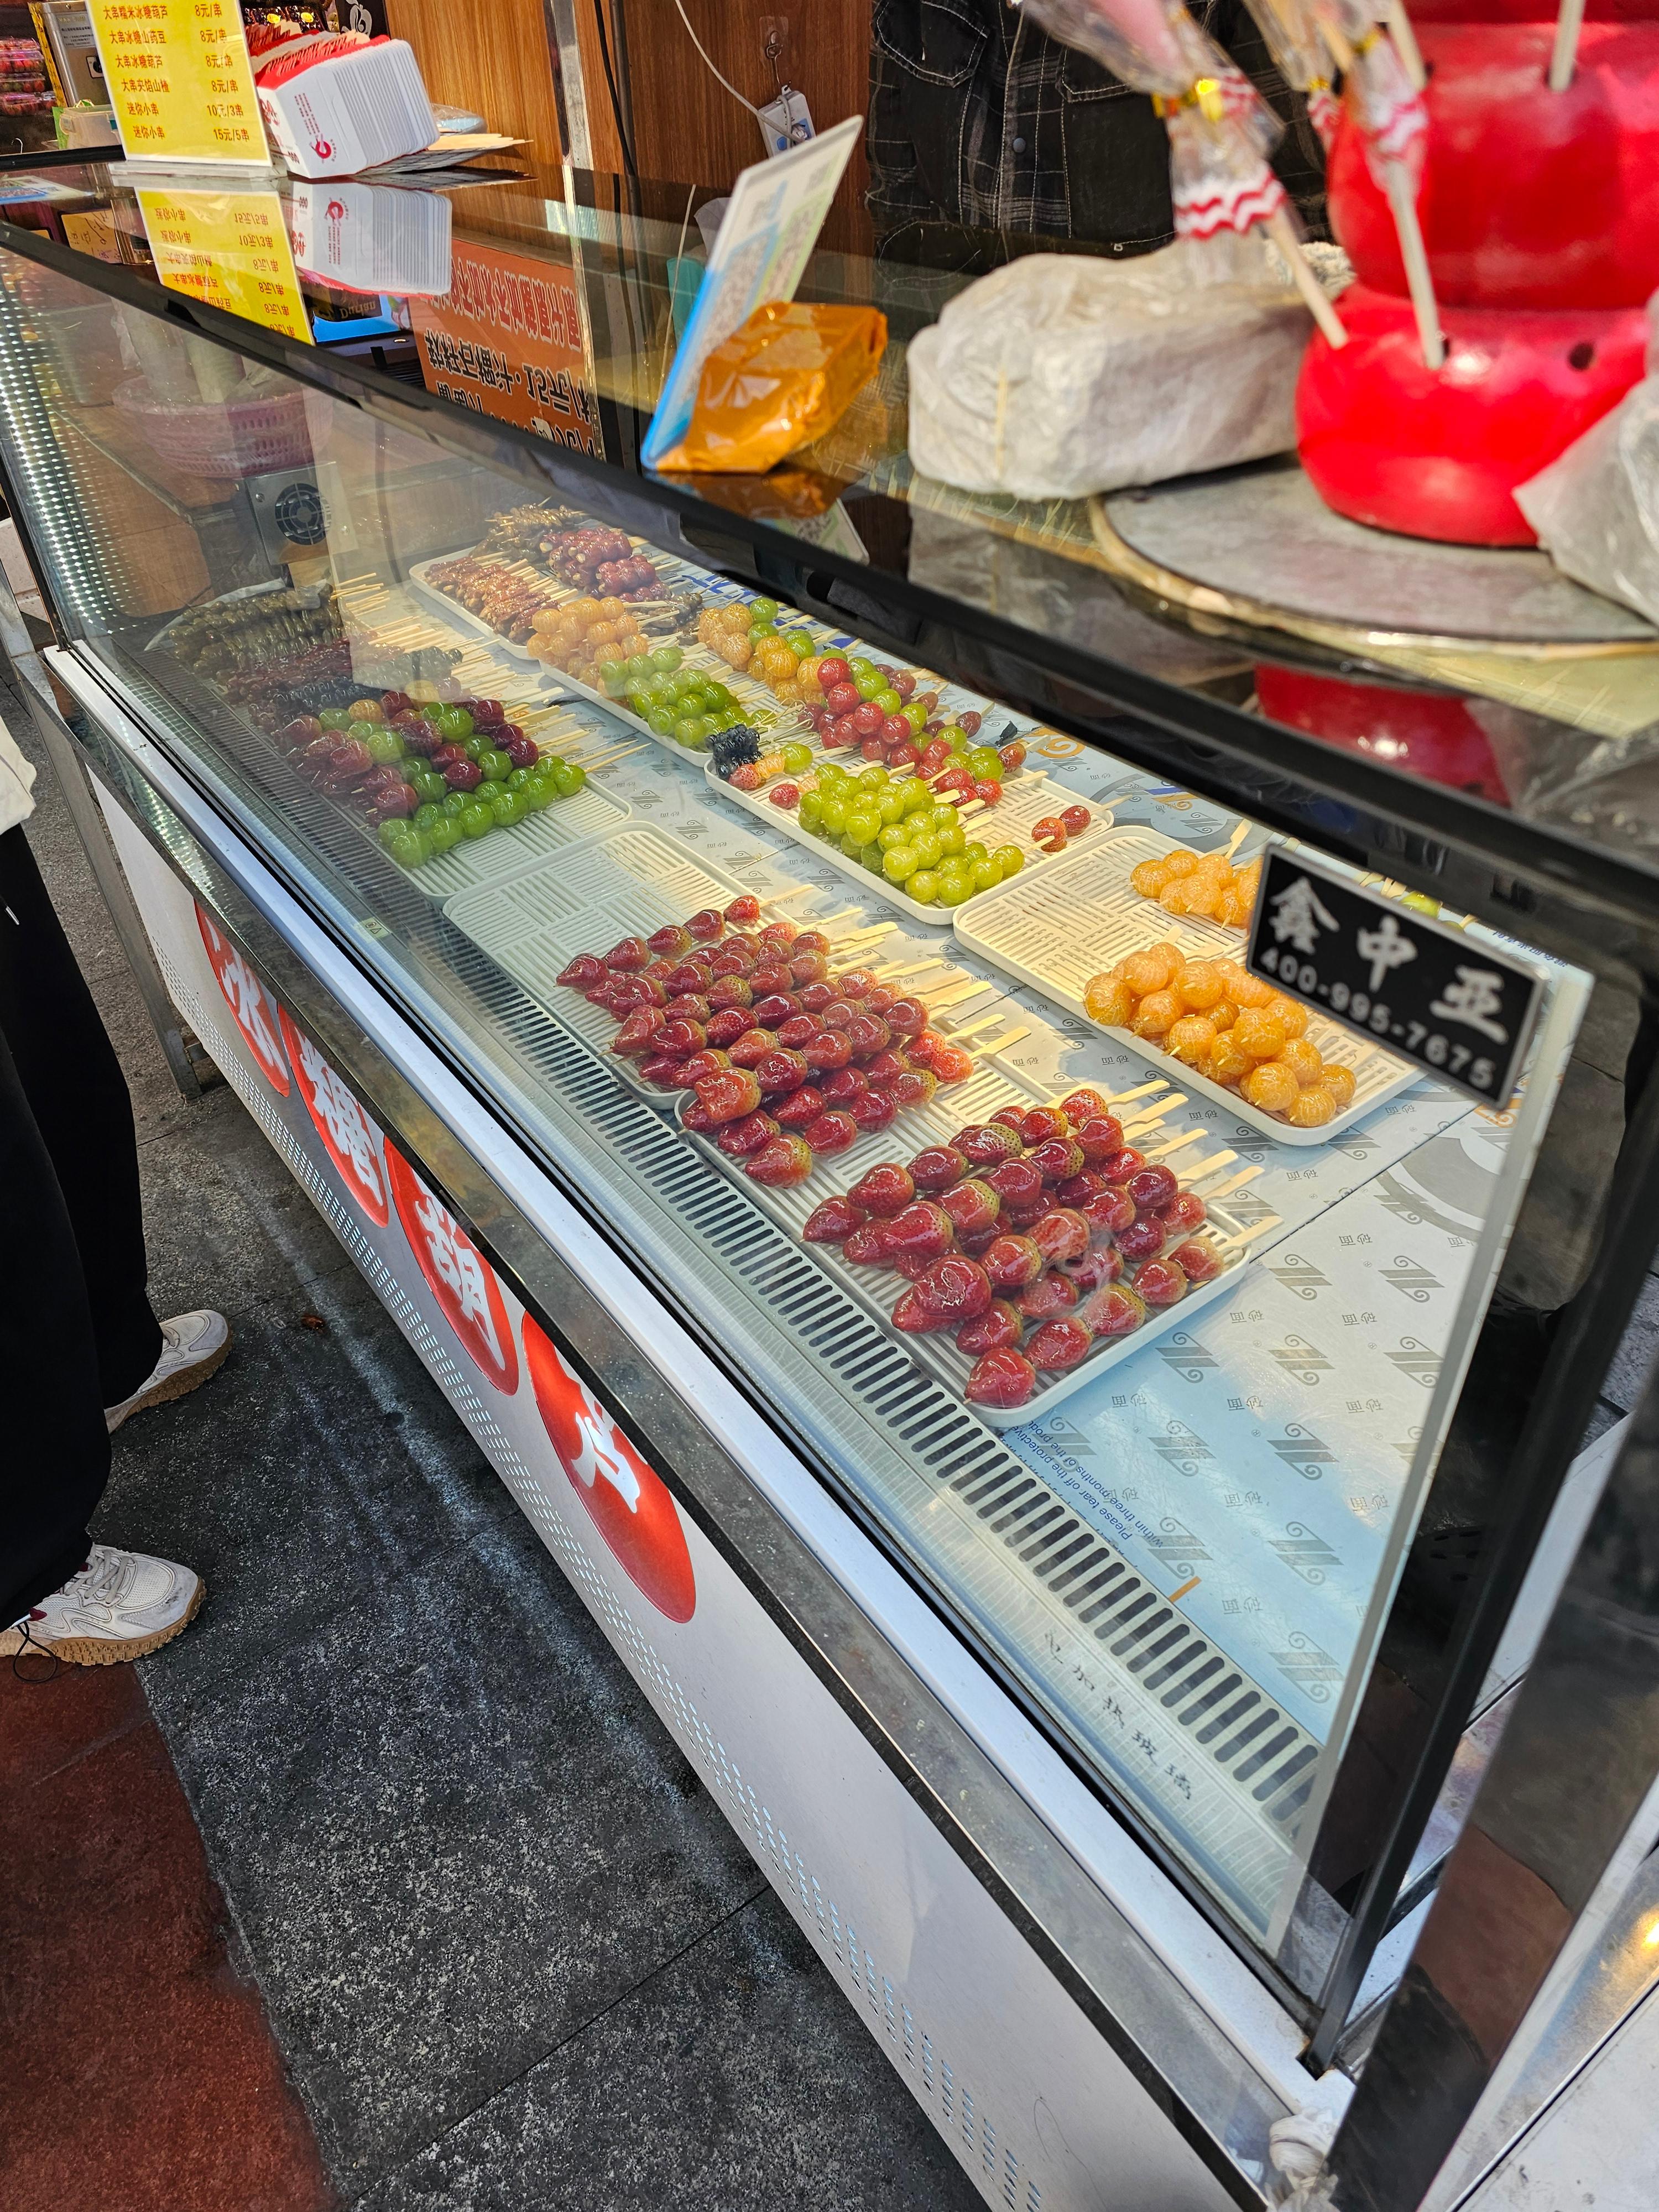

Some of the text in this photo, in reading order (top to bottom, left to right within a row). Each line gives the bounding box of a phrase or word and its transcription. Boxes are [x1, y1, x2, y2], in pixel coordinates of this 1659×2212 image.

[103, 5, 168, 20] 大串糯米冰糖葫芦
[195, 3, 222, 18] 8元/串
[109, 29, 227, 44] 大串冰糖山药豆 8元/串
[115, 53, 233, 69] 大串冰糖葫芦 8元/串
[121, 79, 239, 94] 大串夹馅山楂 8元/串
[127, 102, 159, 116] 迷你小串
[207, 104, 244, 118] 10元/3串
[133, 126, 249, 142] 迷你小串 15元/5串
[1260, 946, 1496, 1090] 400-995-7675
[1188, 1109, 1218, 1121] 砂面
[1286, 1169, 1318, 1182] 砂面
[1338, 1233, 1373, 1246] 砂面
[1229, 1310, 1265, 1323] 砂面
[1342, 1312, 1378, 1326] 砂面
[1112, 1393, 1147, 1408] 砂面
[1227, 1395, 1264, 1411] 砂面
[1346, 1399, 1384, 1413] 砂面
[1011, 1425, 1052, 1463] protective
[1051, 1442, 1067, 1458] the
[1064, 1457, 1077, 1467] of
[1052, 1463, 1067, 1479] the
[1064, 1477, 1080, 1490] off
[1076, 1466, 1112, 1498] months
[1079, 1490, 1099, 1509] tear
[1224, 1491, 1263, 1507] 砂面
[1350, 1495, 1390, 1511] 砂面
[1109, 1498, 1135, 1522] three
[1099, 1507, 1133, 1540] Please
[1135, 1520, 1164, 1548] within
[1222, 1597, 1264, 1614] 砂面
